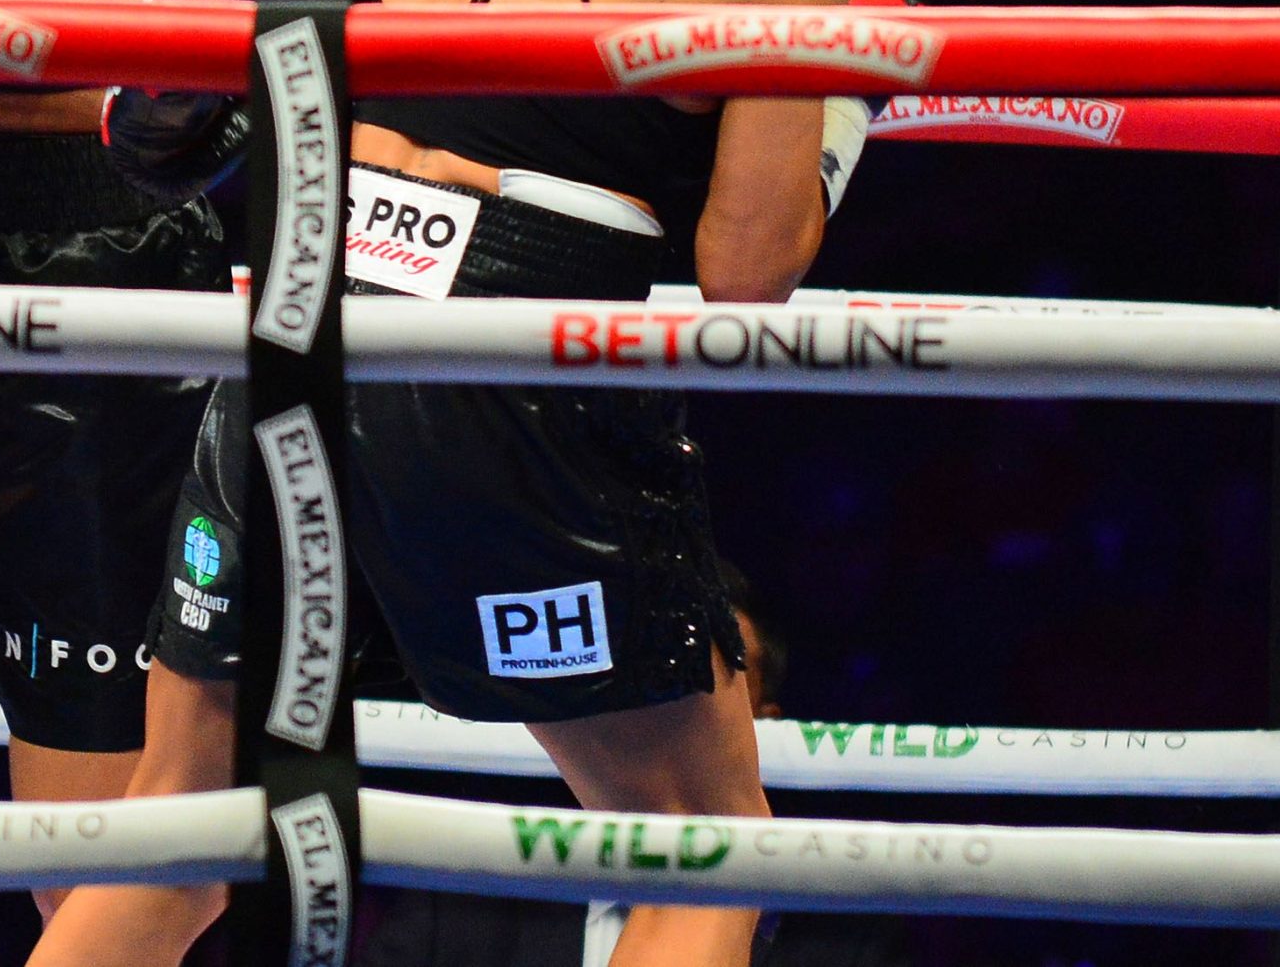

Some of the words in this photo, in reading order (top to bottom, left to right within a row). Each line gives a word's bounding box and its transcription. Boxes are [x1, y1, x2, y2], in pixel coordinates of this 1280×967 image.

[279, 40, 313, 93] EL
[619, 32, 674, 71] EL
[685, 15, 923, 67] MEXICANO
[916, 96, 1111, 131] MEXICANO
[274, 104, 326, 331] MEXICANO
[365, 197, 456, 249] PRO
[550, 312, 951, 370] BETONLINE
[278, 428, 315, 483] EL
[180, 601, 212, 632] CBD
[192, 588, 231, 614] PLANET
[286, 495, 332, 728] MEXICANO
[492, 593, 596, 655] PH
[501, 651, 598, 670] PROTEINHOUSE
[797, 720, 980, 759] WILD
[997, 730, 1188, 750] CASINO
[296, 815, 330, 868] EL
[511, 815, 733, 871] WILD
[753, 828, 994, 866] CASINO
